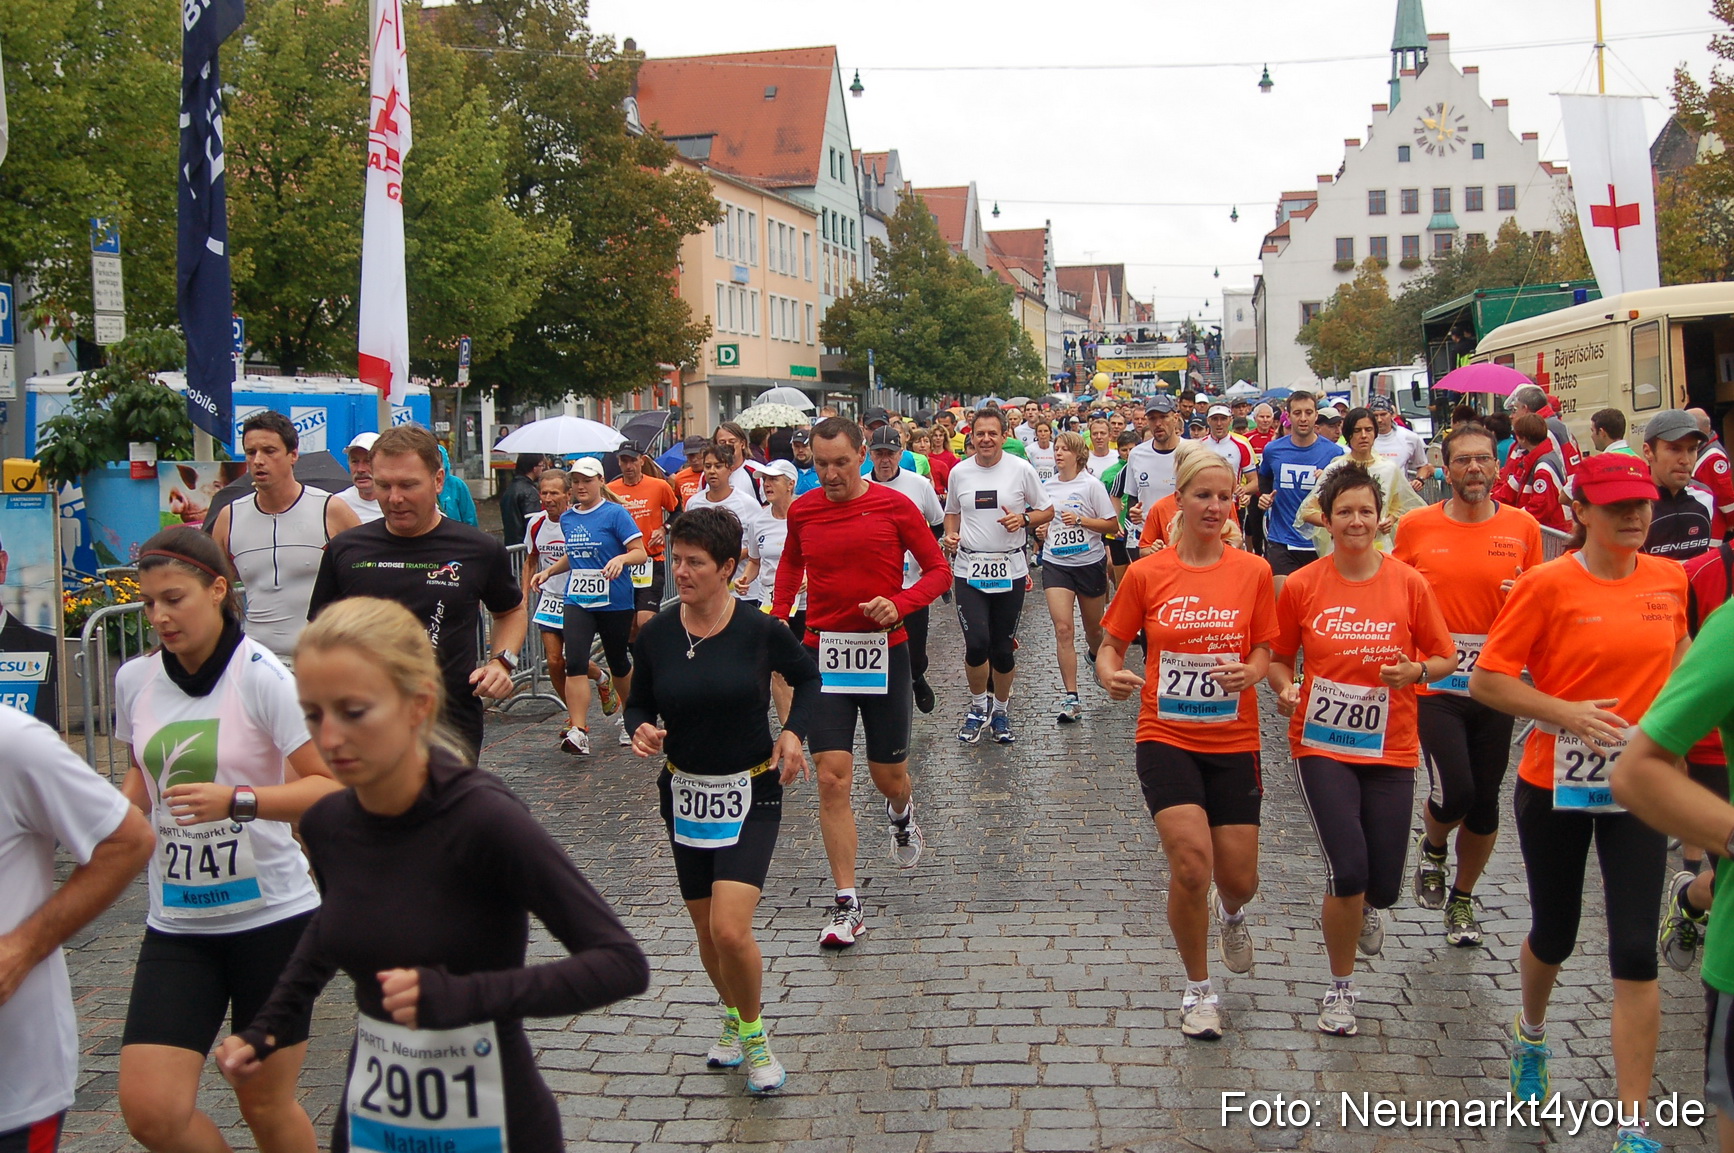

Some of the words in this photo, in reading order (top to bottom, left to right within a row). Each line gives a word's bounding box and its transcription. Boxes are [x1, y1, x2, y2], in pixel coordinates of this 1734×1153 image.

[1554, 341, 1605, 370] Bayerisches
[1126, 361, 1157, 370] START
[1554, 372, 1578, 391] Rotes
[1558, 396, 1577, 414] reuz
[1054, 529, 1085, 546] 2393
[1493, 541, 1514, 549] Team
[1650, 538, 1709, 554] GENESIS
[972, 563, 1007, 578] 2488
[572, 579, 605, 593] 2250
[1646, 601, 1669, 610] Team
[1169, 606, 1240, 622] Fischer
[1174, 621, 1235, 630] AUTOMOBILE
[1325, 618, 1396, 633] Fischer
[1204, 633, 1219, 642] das
[1331, 632, 1391, 641] AUTOMOBILE
[1360, 645, 1375, 654] das
[826, 647, 882, 670] 3102
[1161, 657, 1186, 667] PARTL
[0, 661, 26, 672] CSU
[1313, 682, 1338, 697] PARTL
[1339, 690, 1376, 702] Neumarkt
[1178, 702, 1217, 714] Kristina
[1313, 696, 1381, 731] 2780
[1328, 731, 1356, 746] Anita
[673, 776, 697, 788] PARTL
[698, 780, 734, 789] Neumarkt
[679, 788, 743, 819] 3053
[160, 826, 181, 838] PARTL
[182, 827, 226, 840] Neumarkt
[165, 839, 238, 881] 2747
[182, 890, 230, 905] Kerstin
[359, 1028, 389, 1053] PARTL
[392, 1041, 467, 1060] Neumarkt
[360, 1055, 479, 1122] 2901
[383, 1129, 456, 1153] Natalie
